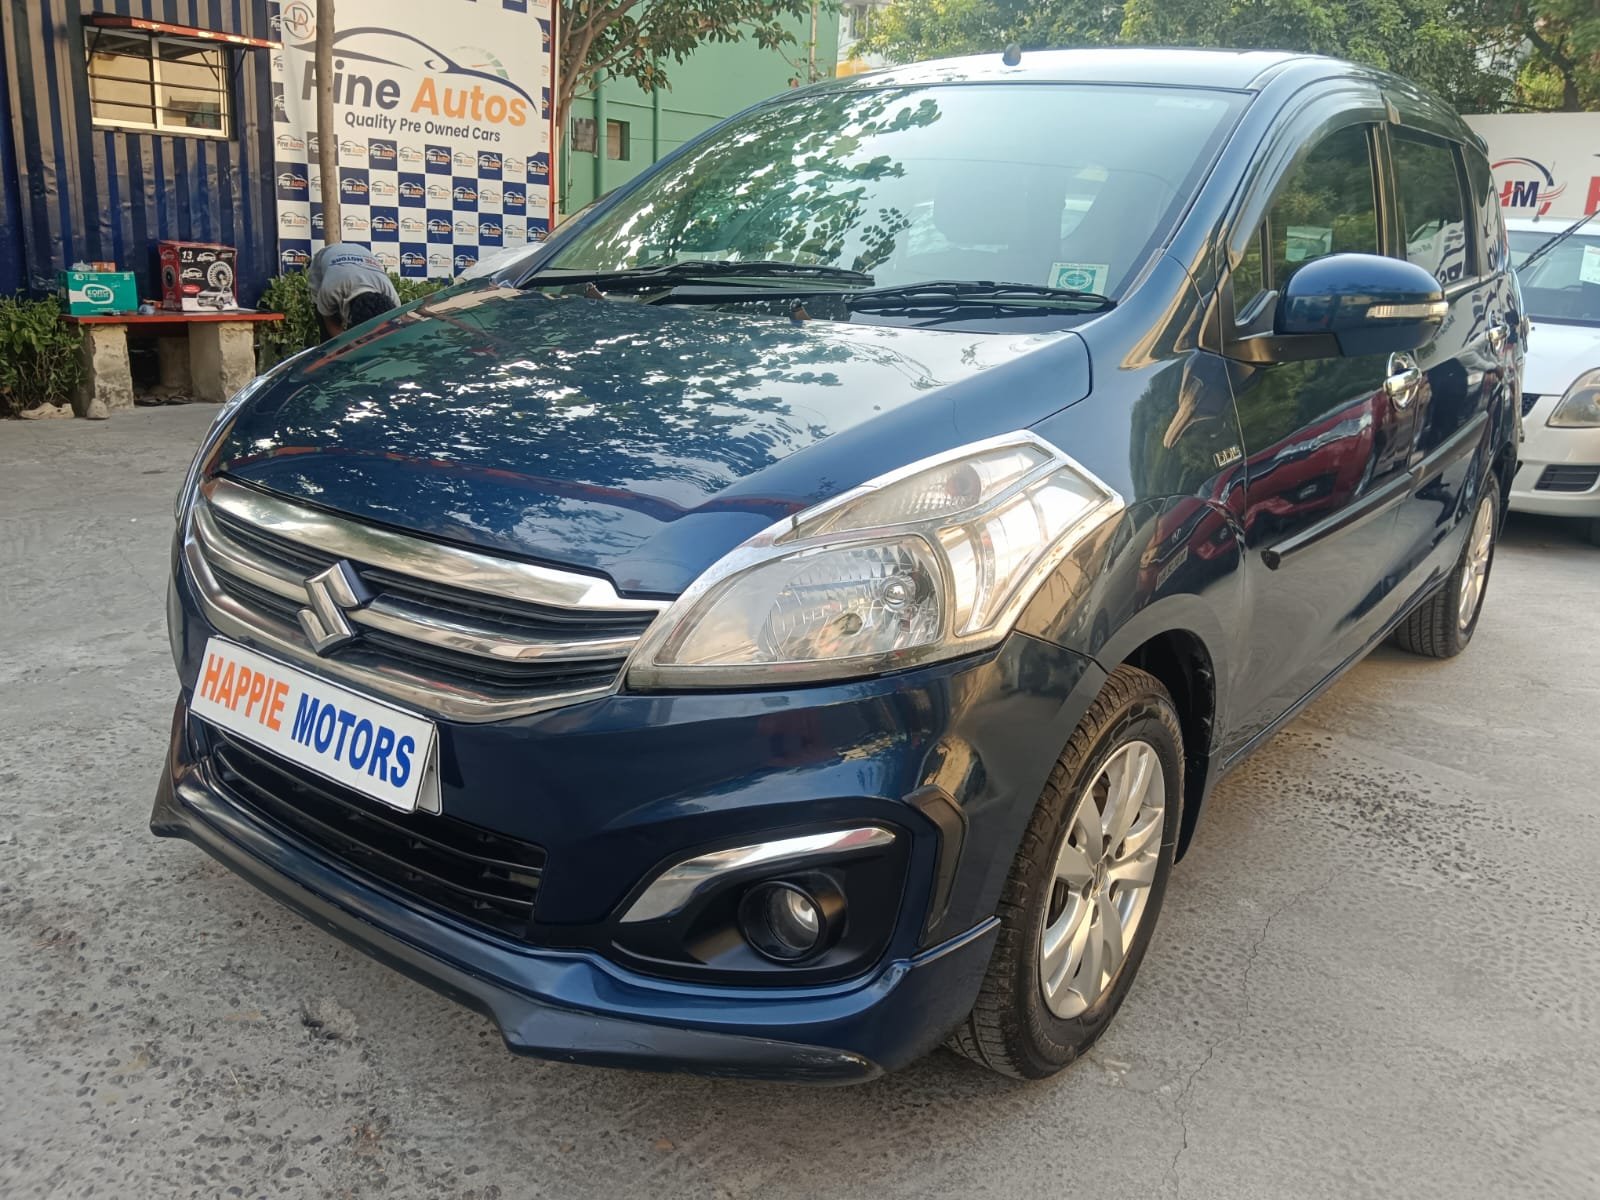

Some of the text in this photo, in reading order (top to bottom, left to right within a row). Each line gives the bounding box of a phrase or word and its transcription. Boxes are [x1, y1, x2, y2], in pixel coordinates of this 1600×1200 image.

[344, 111, 501, 143] Quality Pre Owned Cars
[410, 77, 527, 127] Autos
[200, 653, 415, 788] HAPPIE MOTORS
